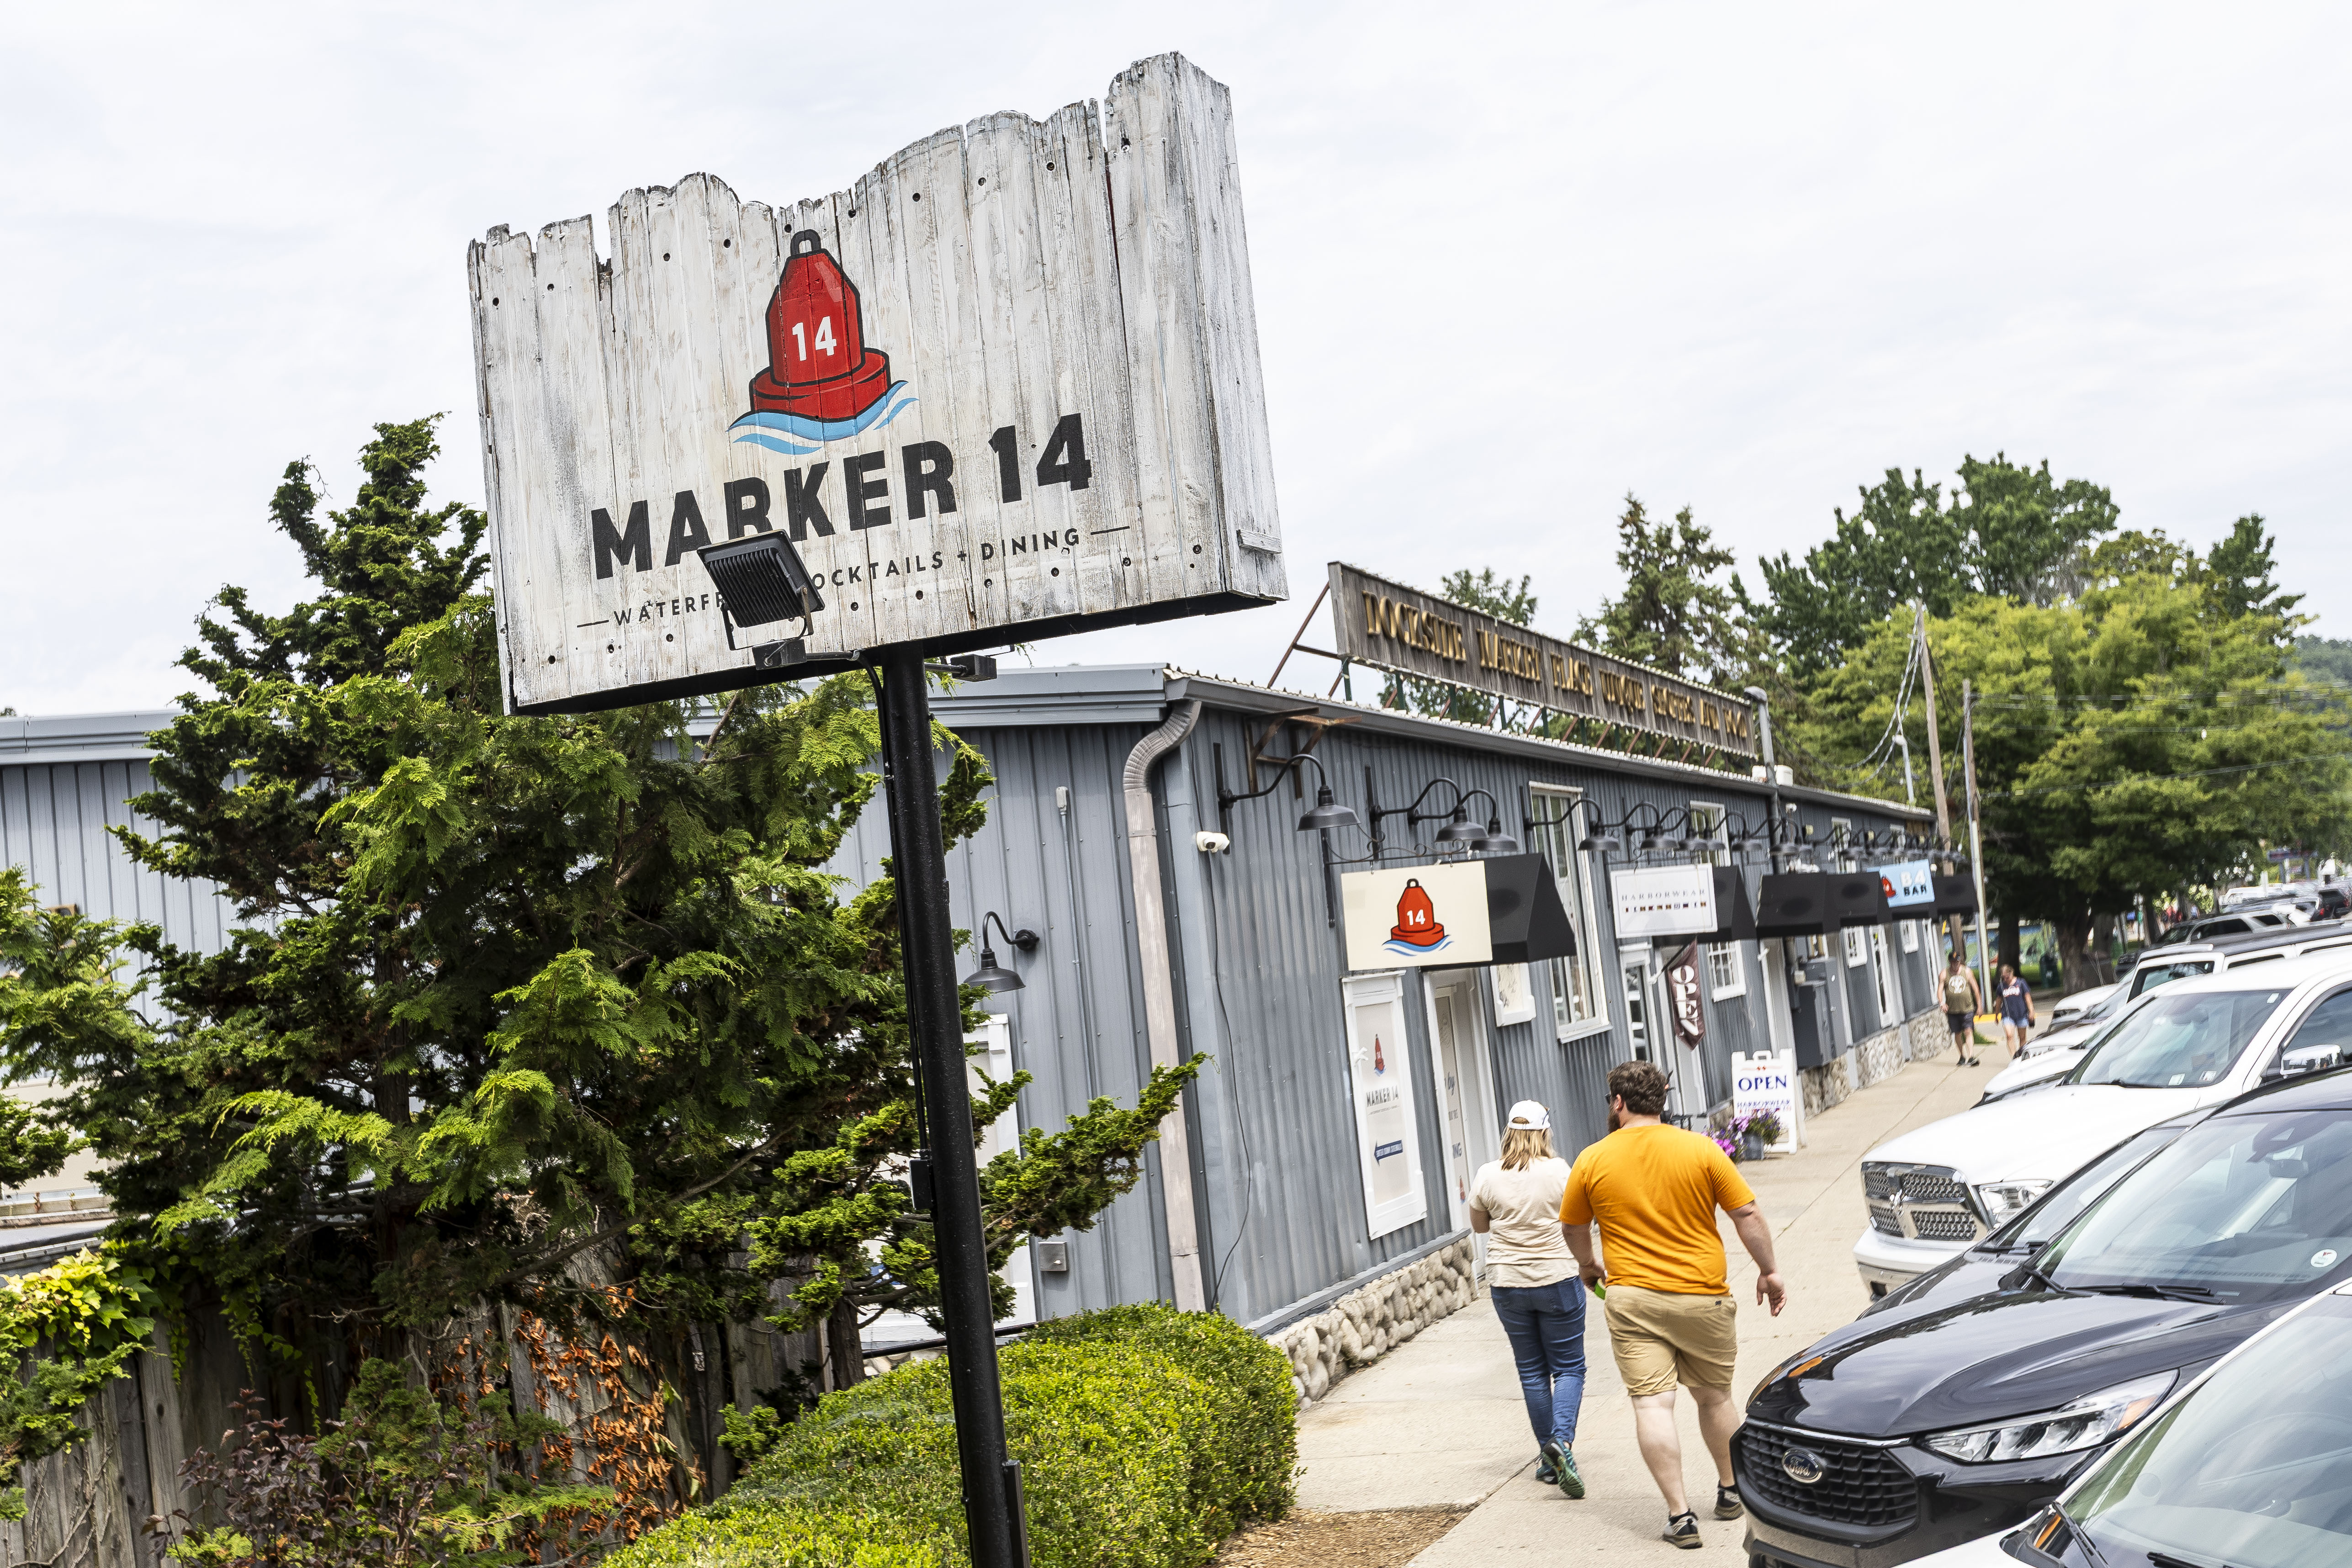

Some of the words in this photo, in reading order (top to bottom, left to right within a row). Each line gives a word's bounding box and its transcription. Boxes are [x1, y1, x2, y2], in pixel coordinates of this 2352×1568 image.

[792, 316, 837, 361] 14
[591, 440, 957, 579] MARKER
[988, 413, 1092, 503] 14
[614, 592, 727, 626] WATERFR
[813, 551, 943, 590] OCKTAILS
[981, 528, 1080, 561] DINING
[1362, 590, 1467, 663] DOCKSIDE
[1476, 628, 1542, 682] MARKET
[1550, 653, 1594, 697] PLACE
[1622, 889, 1705, 901] HARBORWEAR
[1903, 884, 1927, 896] BAR
[1406, 909, 1426, 926] 14
[1672, 965, 1700, 1036] OPEN
[1366, 1087, 1391, 1107] MARKER
[1393, 1085, 1399, 1101] 14
[1738, 1075, 1787, 1091] OPEN
